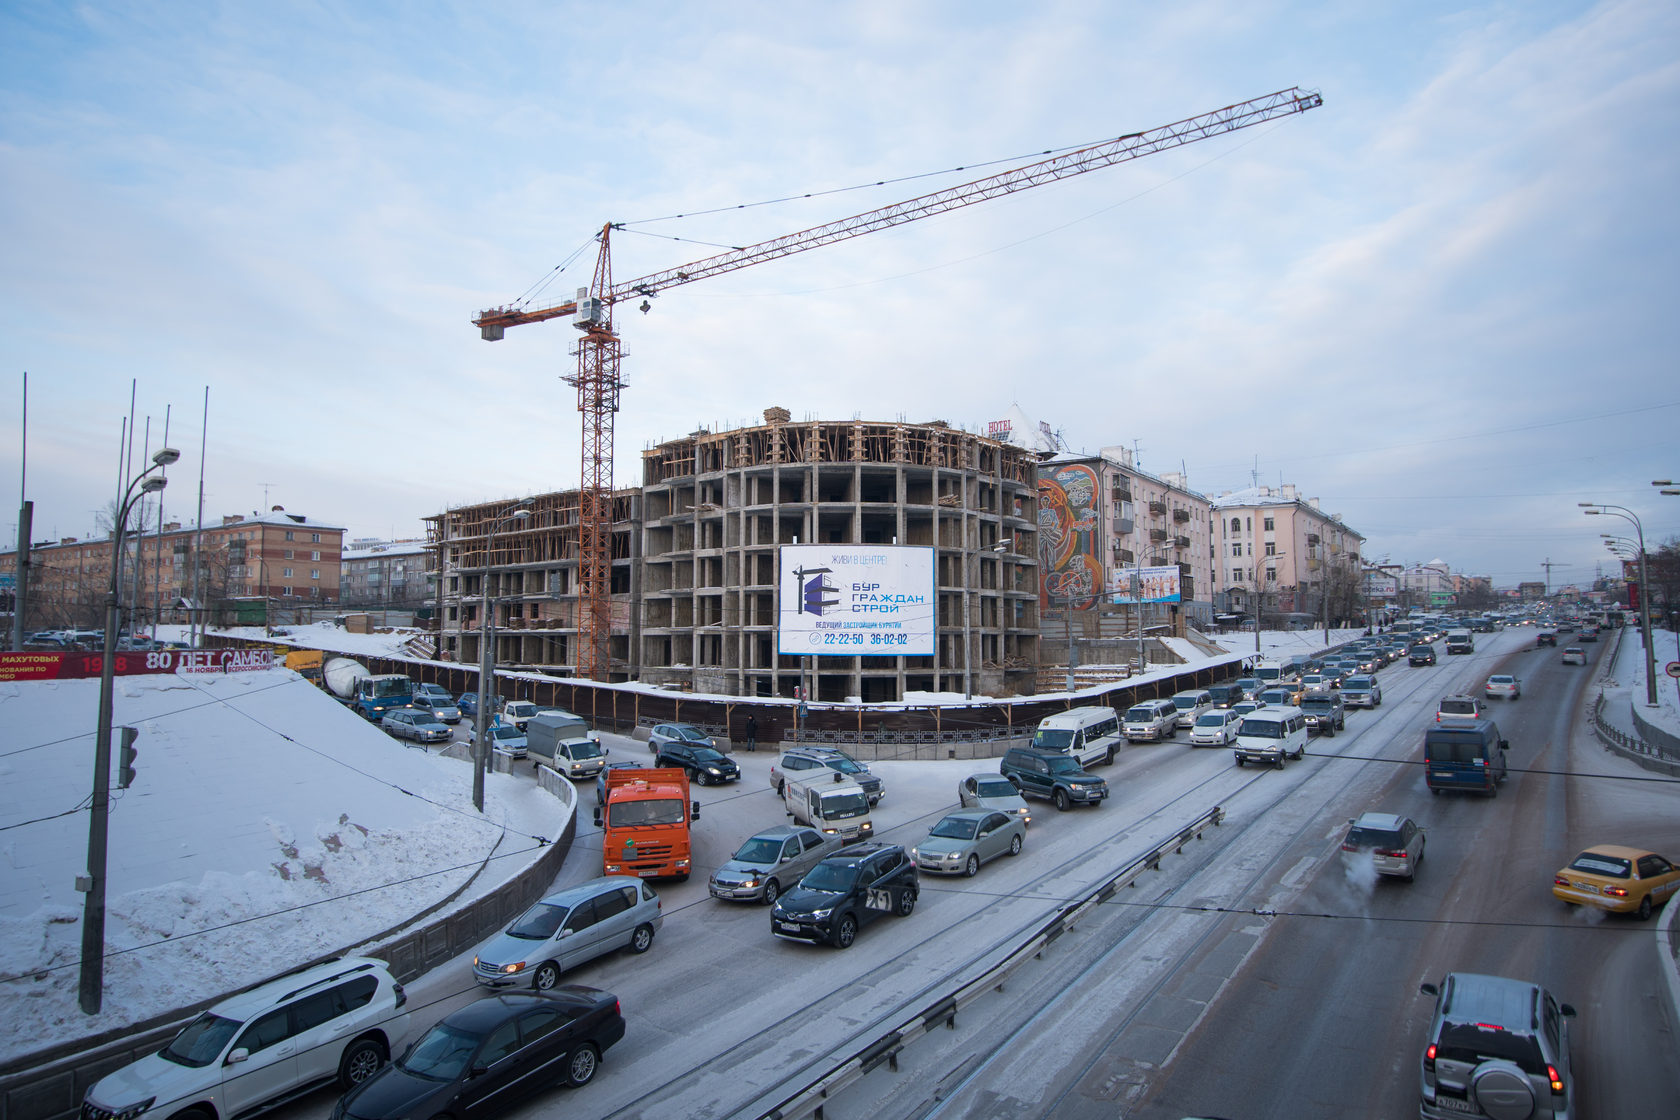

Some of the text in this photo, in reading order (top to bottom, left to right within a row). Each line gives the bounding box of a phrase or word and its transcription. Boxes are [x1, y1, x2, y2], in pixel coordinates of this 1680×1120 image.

[988, 420, 1012, 432] HOTEL
[832, 554, 852, 565] ЖИВИ
[853, 555, 859, 565] В
[852, 583, 880, 592] БУР
[852, 594, 924, 604] ГРАЖДАН
[852, 603, 899, 613] СТРОЙ
[815, 621, 842, 629] ВЕДУЩИЙ
[843, 621, 878, 629] ЗАСТРОЙЩИК
[824, 633, 908, 645] 22-22-50 36-02-02
[82, 657, 128, 672] 198
[146, 652, 172, 669] 80
[178, 652, 216, 667] ЛЕТ
